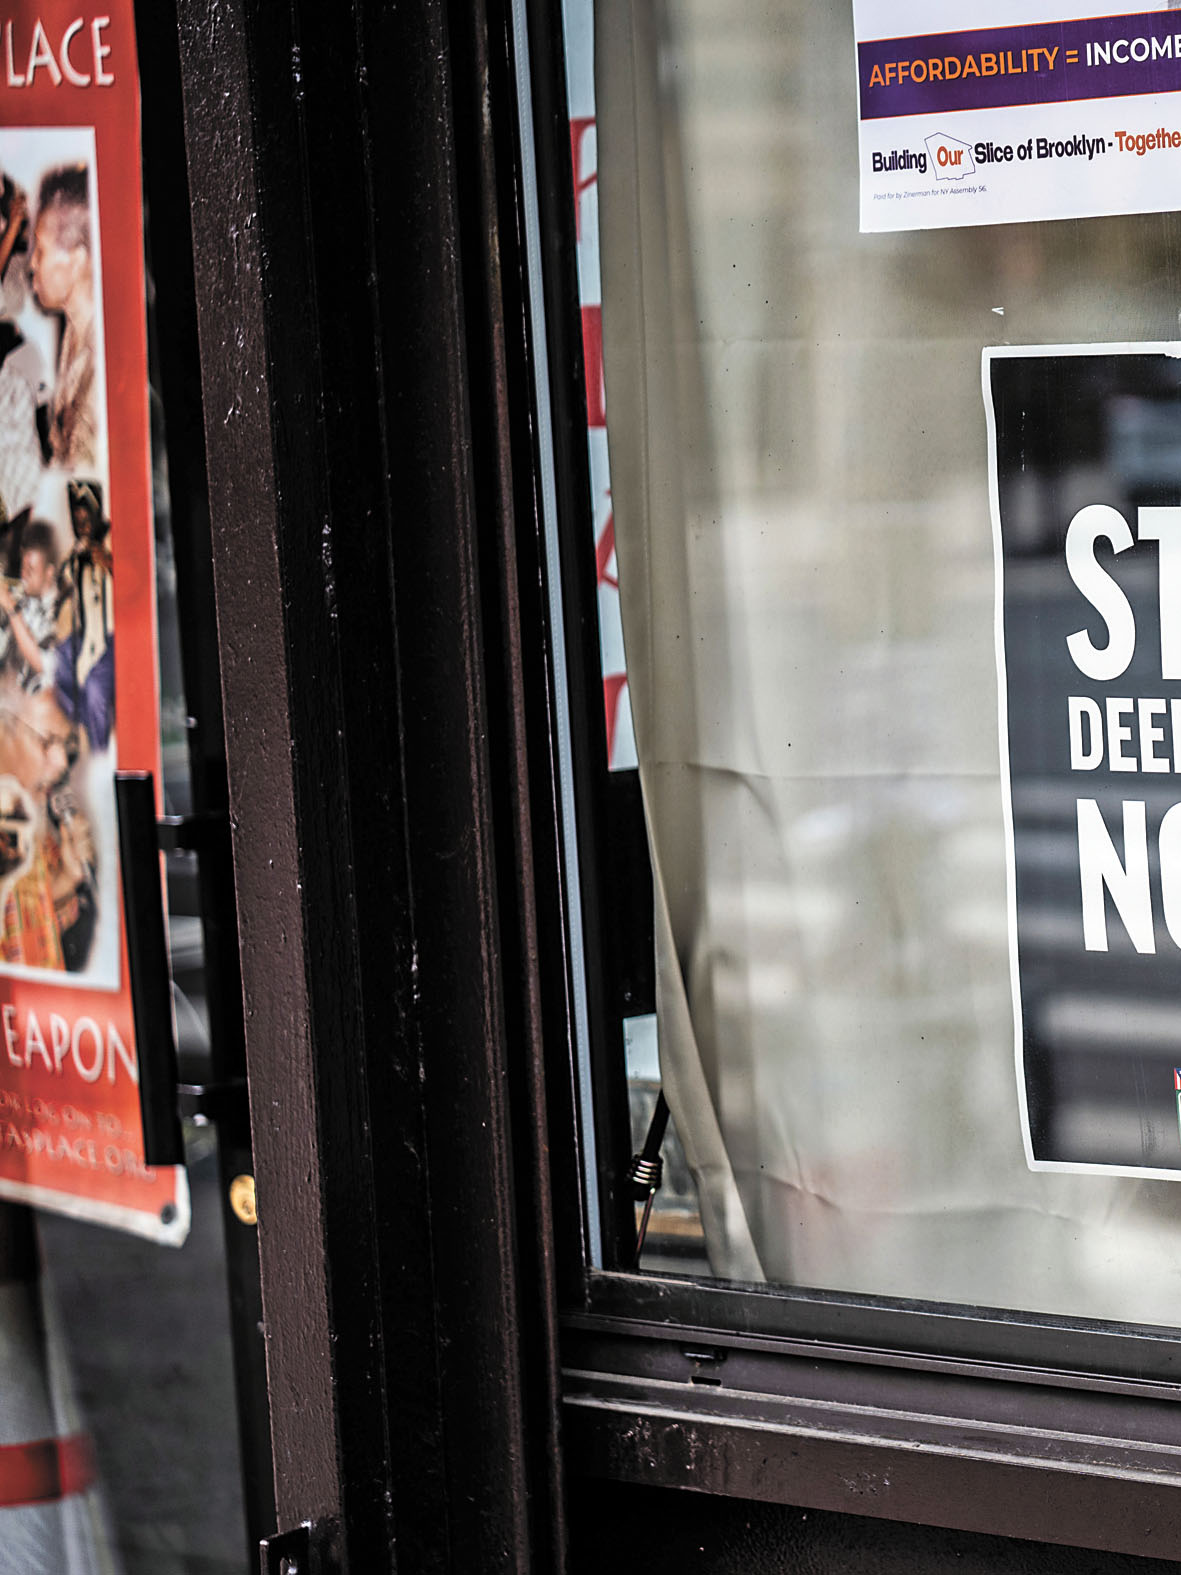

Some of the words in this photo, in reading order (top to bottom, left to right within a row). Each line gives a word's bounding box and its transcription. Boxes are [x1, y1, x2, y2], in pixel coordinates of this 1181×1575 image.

[0, 16, 115, 88] LACE
[869, 47, 1059, 87] AFFORDABILITY
[1066, 50, 1079, 63] =
[872, 150, 927, 173] Building
[936, 146, 964, 167] Our
[974, 141, 1014, 164] Slice
[1017, 139, 1033, 160] of
[1036, 134, 1106, 159] Brooklyn
[949, 186, 978, 194] Assembly
